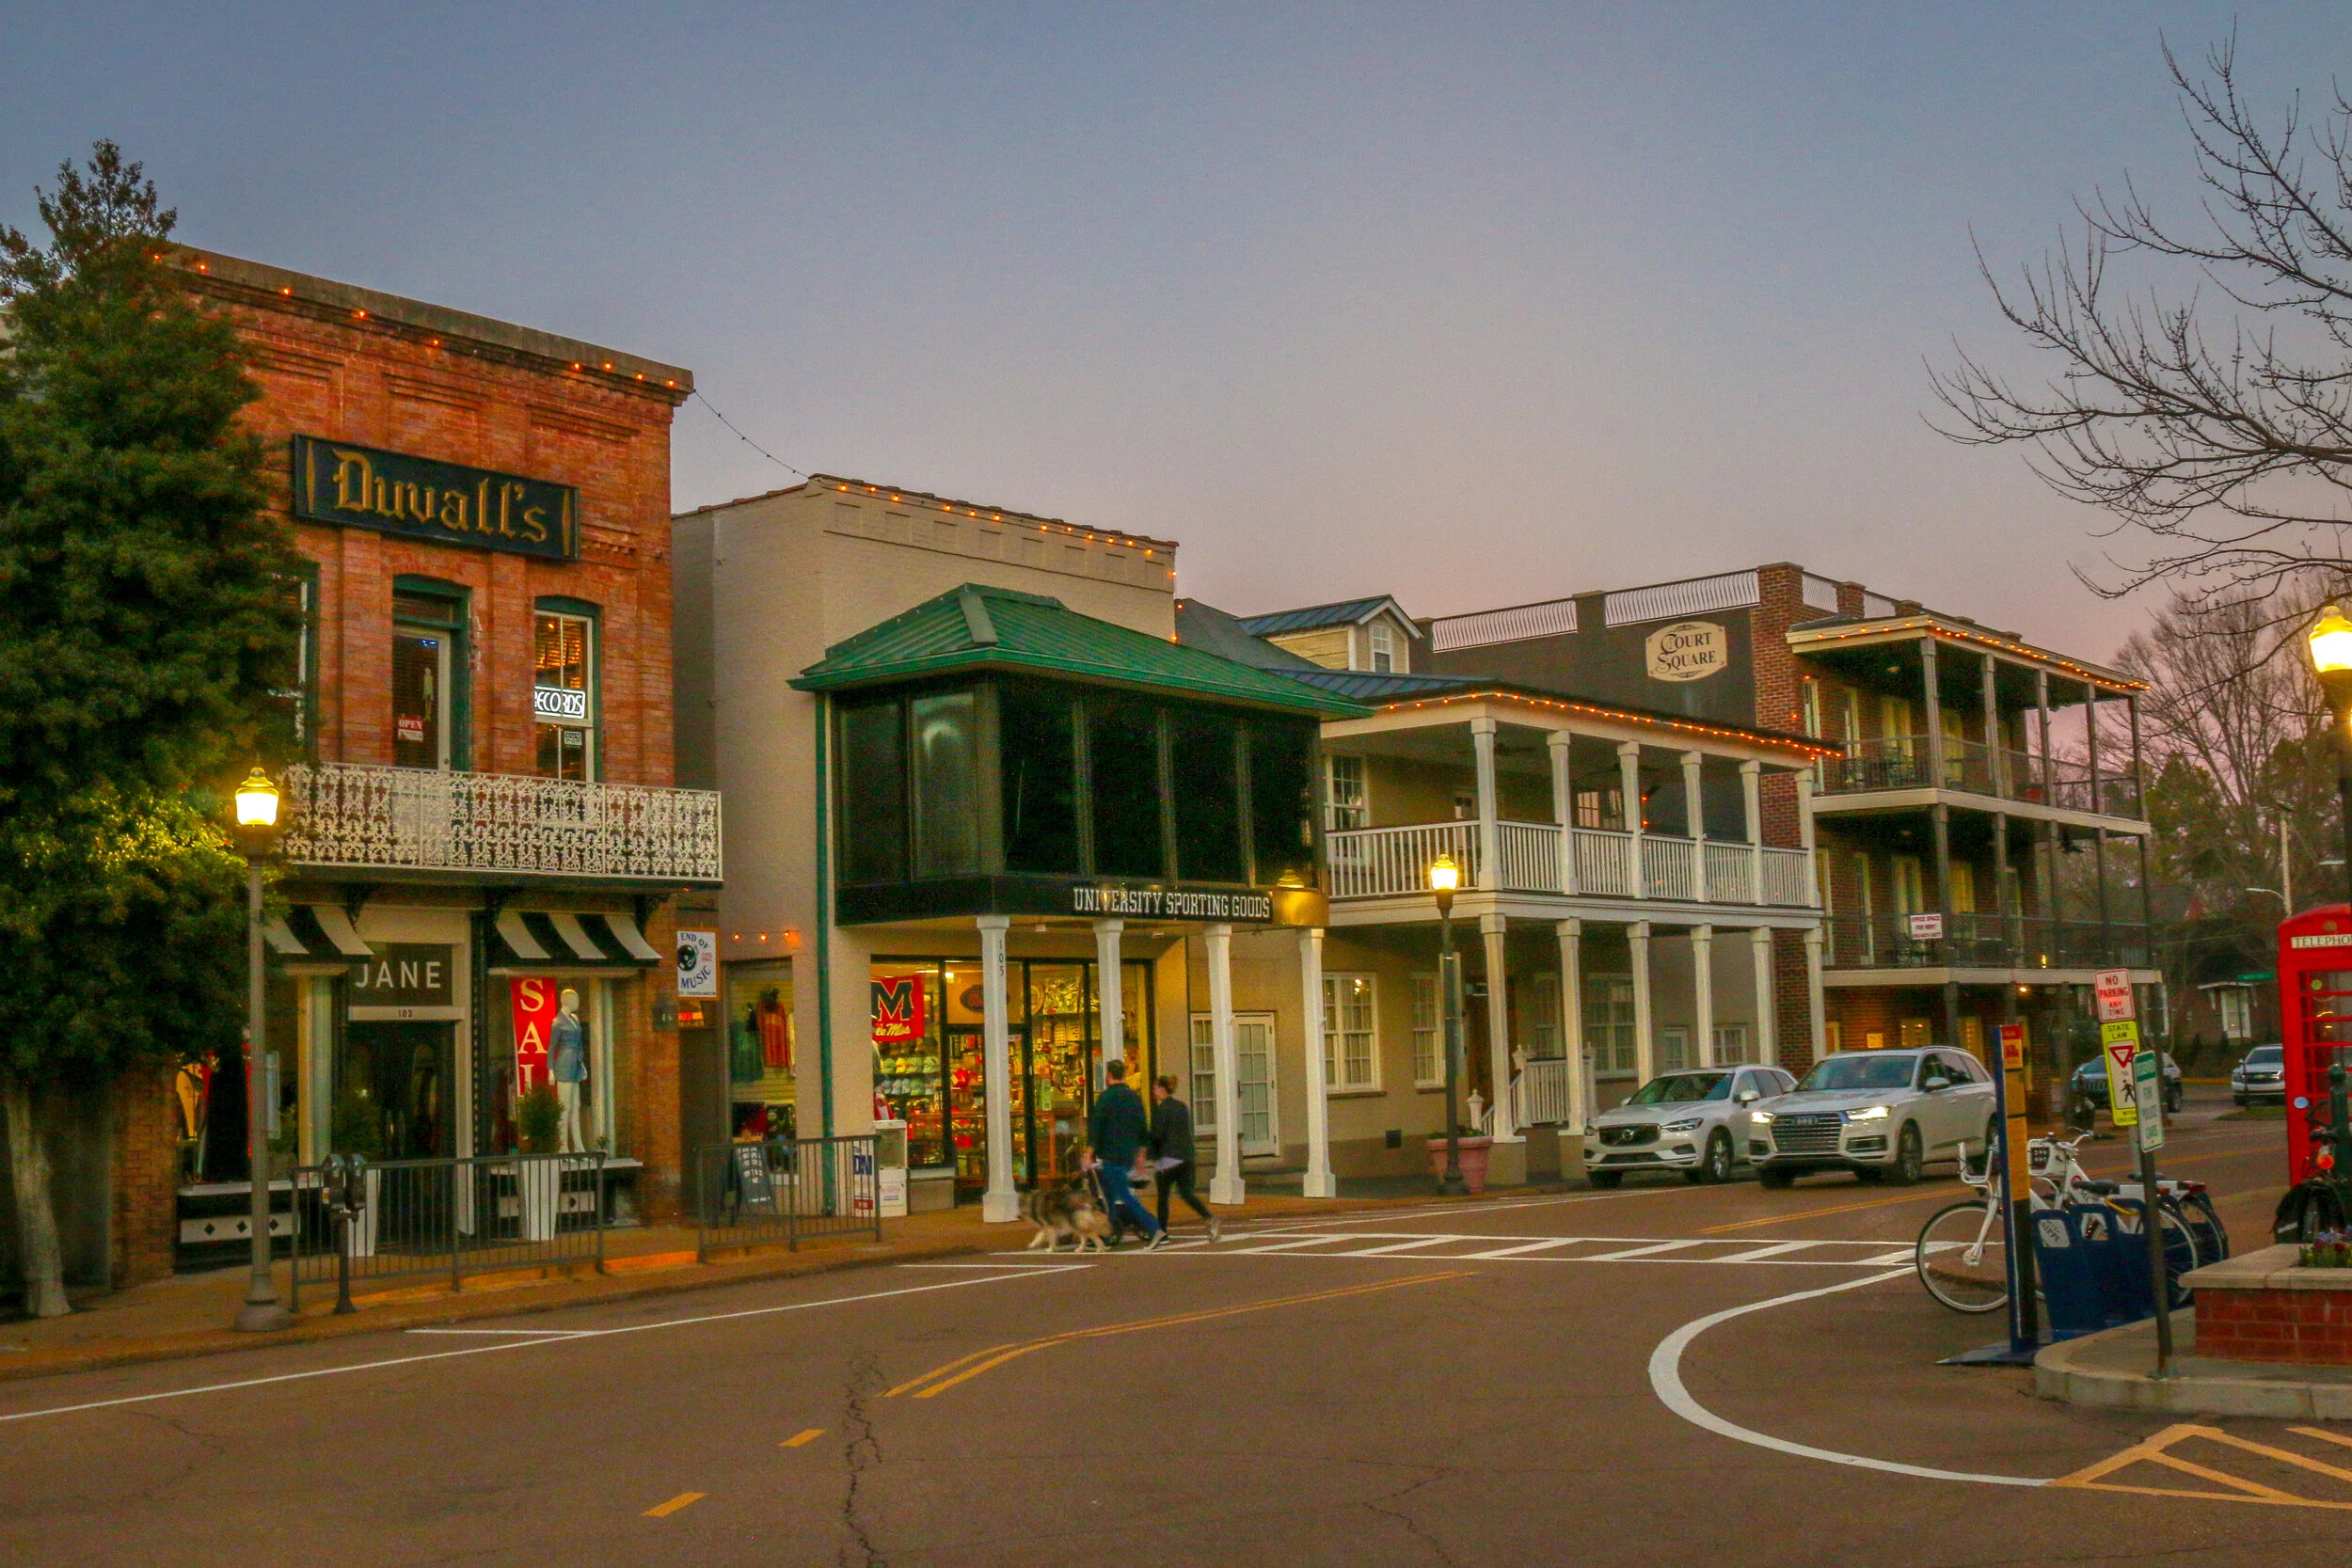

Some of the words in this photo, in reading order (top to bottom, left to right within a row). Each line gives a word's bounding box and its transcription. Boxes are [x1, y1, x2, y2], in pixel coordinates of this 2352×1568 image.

[332, 448, 548, 543] Duvall's
[1660, 632, 1712, 654] COURT
[1656, 650, 1717, 674] SQUARE
[399, 719, 422, 730] OPEN
[1073, 888, 1163, 914] UNIVERSITY
[1167, 893, 1228, 917] SPORTING
[1232, 895, 1270, 918] GOODS
[680, 932, 697, 942] END
[698, 939, 709, 950] OF
[2293, 935, 2352, 948] TELEPHO
[355, 960, 441, 989] JANE
[680, 965, 711, 990] MUSIC
[2105, 974, 2119, 986] NO
[870, 980, 914, 1022] M
[2098, 987, 2129, 998] PARKING
[2108, 1008, 2125, 1017] TIME
[2109, 1000, 2122, 1008] ANY
[2107, 1023, 2131, 1032] STATE
